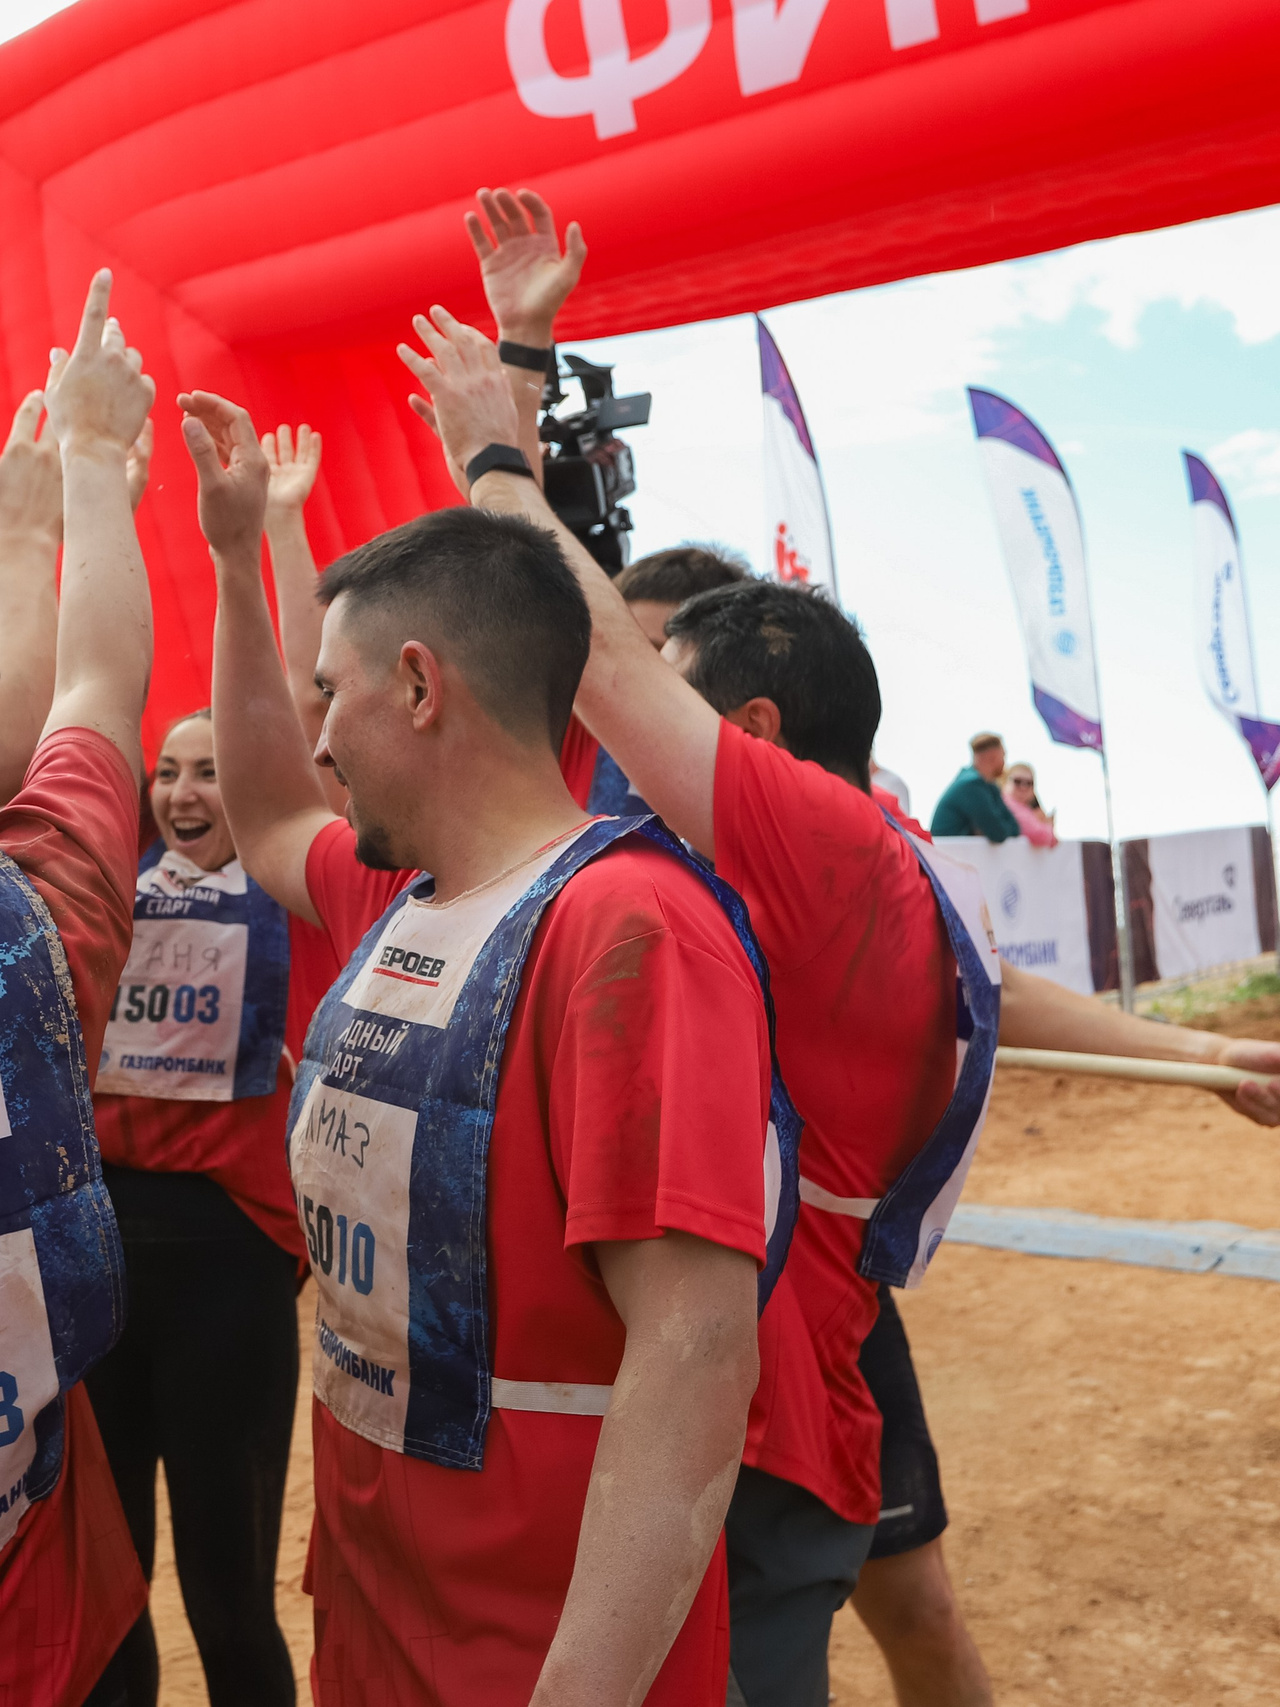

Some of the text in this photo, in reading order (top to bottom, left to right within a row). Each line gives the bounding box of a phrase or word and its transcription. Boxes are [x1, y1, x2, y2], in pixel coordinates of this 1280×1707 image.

[146, 900, 192, 915] СТАРТ
[128, 933, 222, 973] АНЯ
[120, 1054, 226, 1076] ГАЗПРОМБАНК
[299, 1193, 375, 1296] 5010
